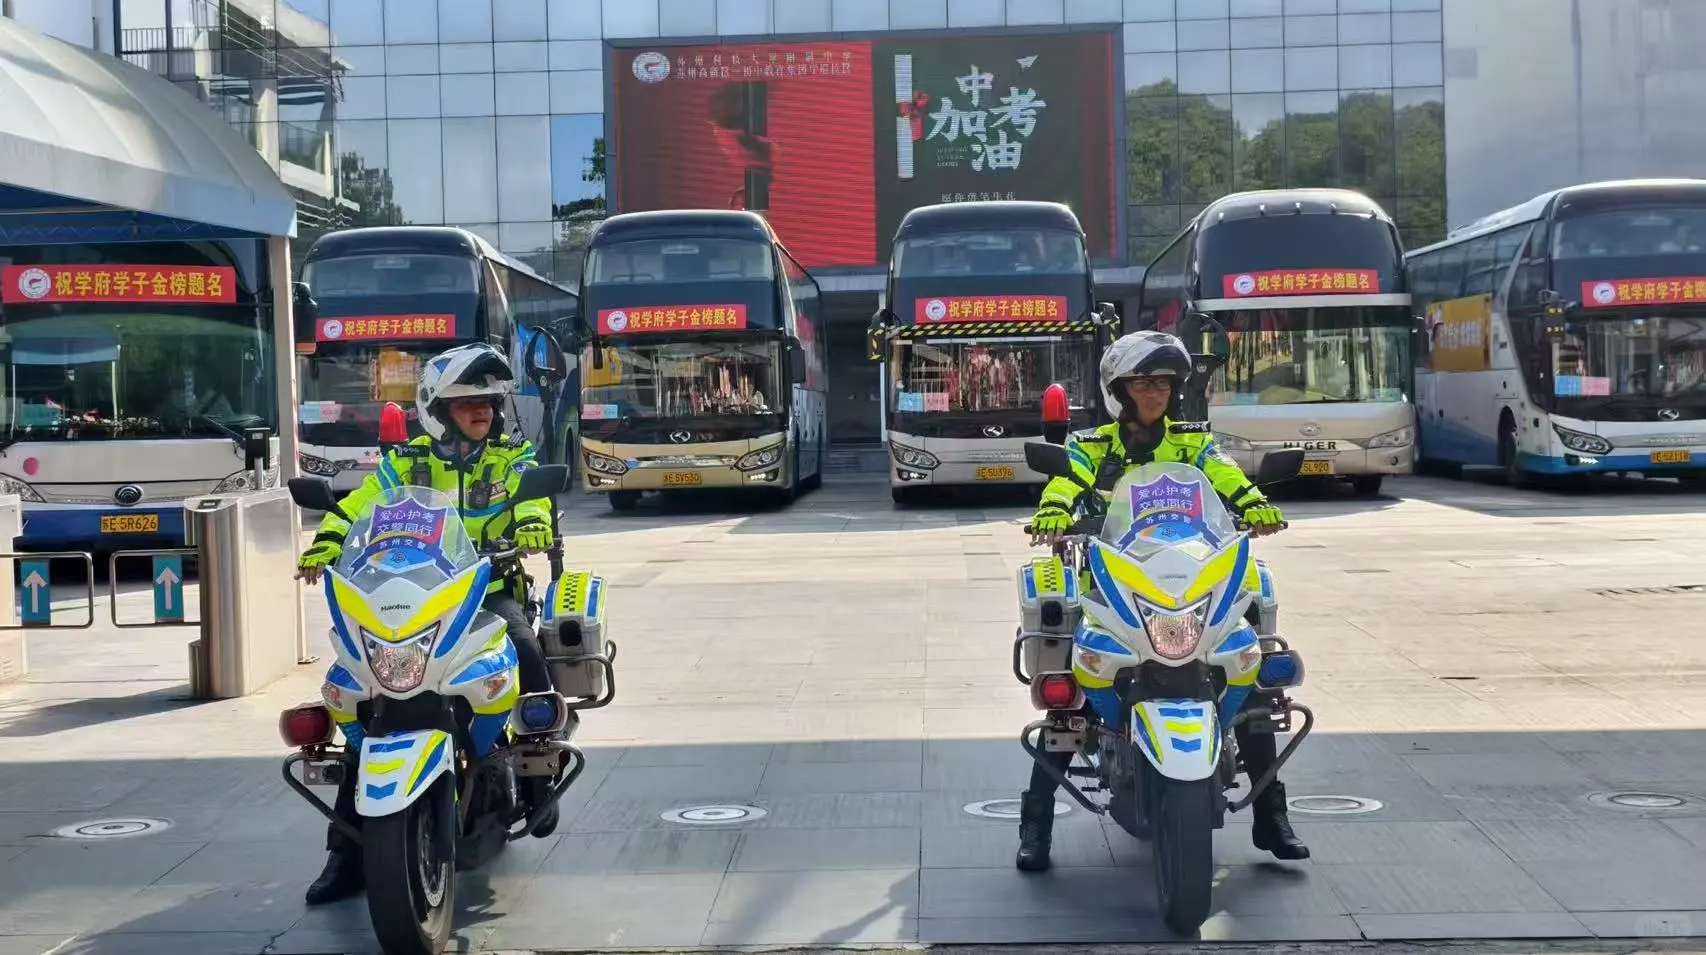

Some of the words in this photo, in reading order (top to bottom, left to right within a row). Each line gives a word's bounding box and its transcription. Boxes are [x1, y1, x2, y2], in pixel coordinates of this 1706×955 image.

[55, 271, 223, 296] 祝学府学子金榜题名
[1258, 272, 1370, 291] 祝学府学子金榜题名
[949, 299, 1058, 318] 祝学府学子金榜题名
[344, 317, 447, 336] 祝学府学子金榜题名
[630, 308, 737, 328] 祝学府学子金榜题名
[1283, 441, 1337, 450] HIGER
[1137, 486, 1192, 500] 爱心护考
[1138, 498, 1194, 511] 交警同行
[380, 510, 436, 523] 爱心护考
[376, 522, 433, 537] 交警同行
